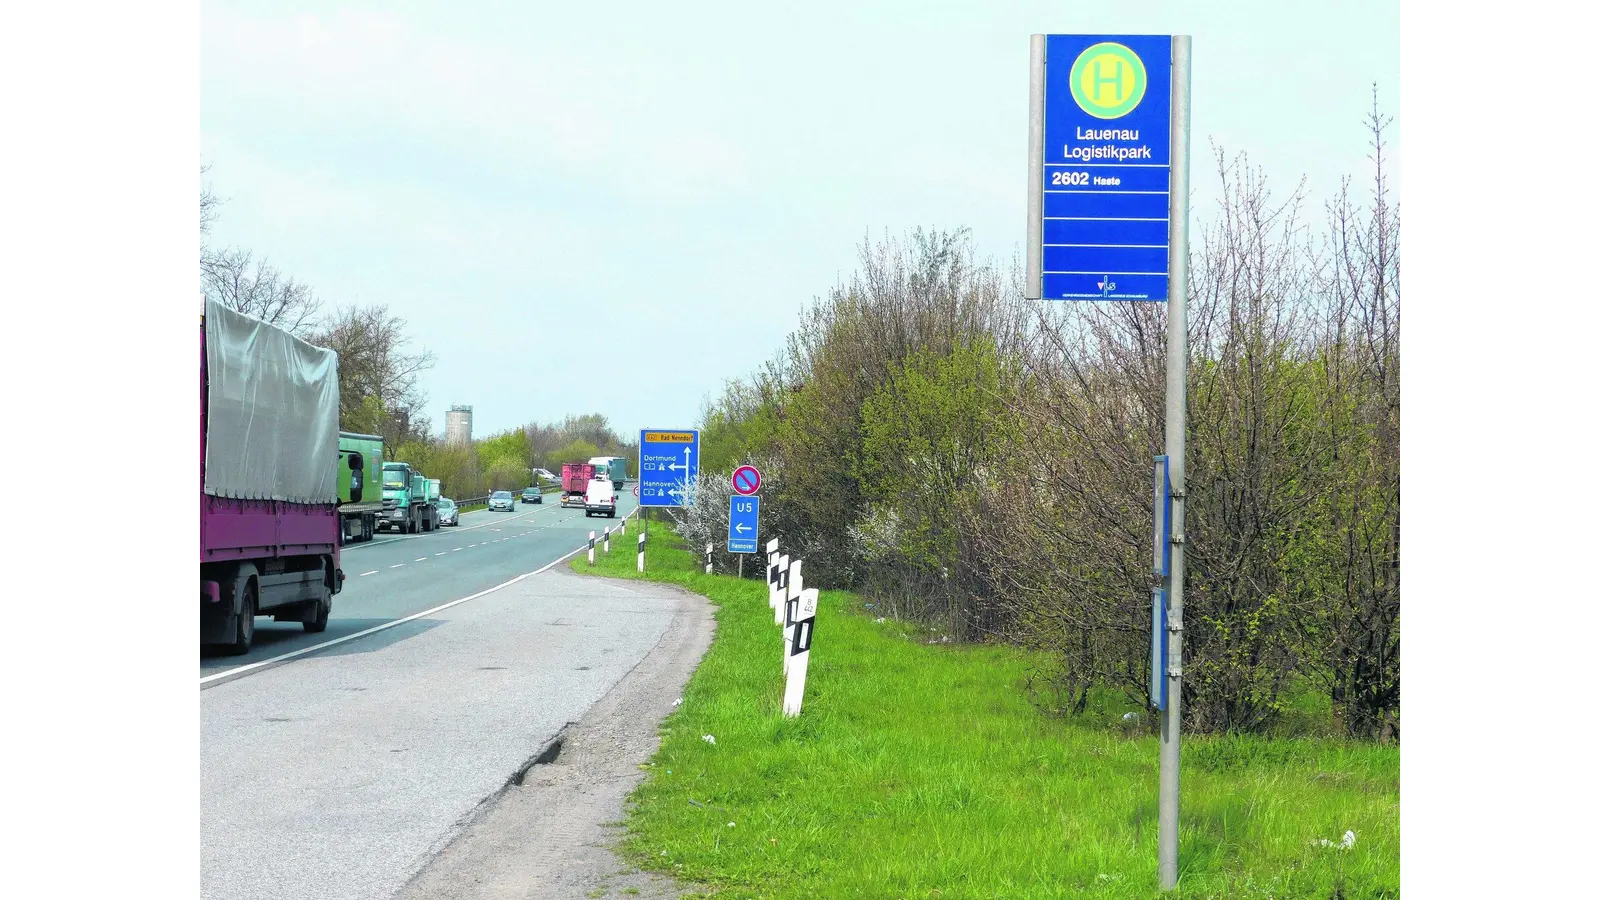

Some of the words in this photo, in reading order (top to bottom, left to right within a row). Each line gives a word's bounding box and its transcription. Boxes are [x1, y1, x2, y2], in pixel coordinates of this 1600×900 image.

[1093, 61, 1122, 101] H
[1076, 126, 1139, 141] Lauenau
[1063, 144, 1152, 162] Logistikpark
[1051, 171, 1090, 186] 2602
[1093, 176, 1121, 186] Haste
